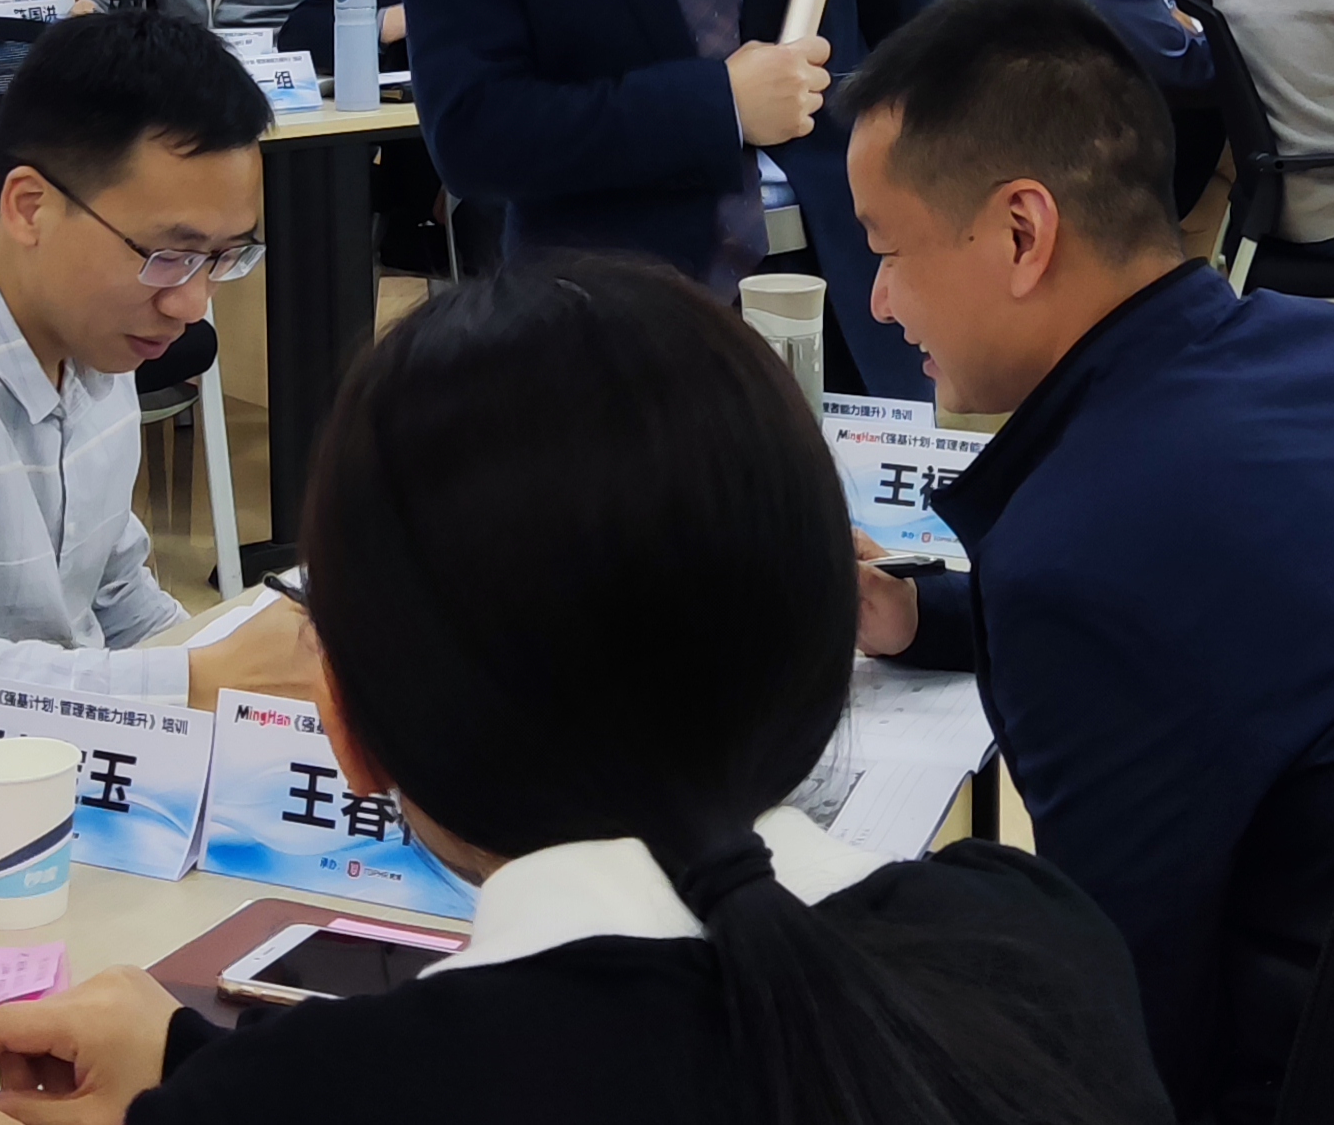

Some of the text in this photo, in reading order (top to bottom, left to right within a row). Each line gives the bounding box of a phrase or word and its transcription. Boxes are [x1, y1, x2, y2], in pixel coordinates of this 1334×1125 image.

[250, 71, 296, 89] 一组
[235, 704, 291, 726] MingHan
[282, 761, 412, 846] 王春
